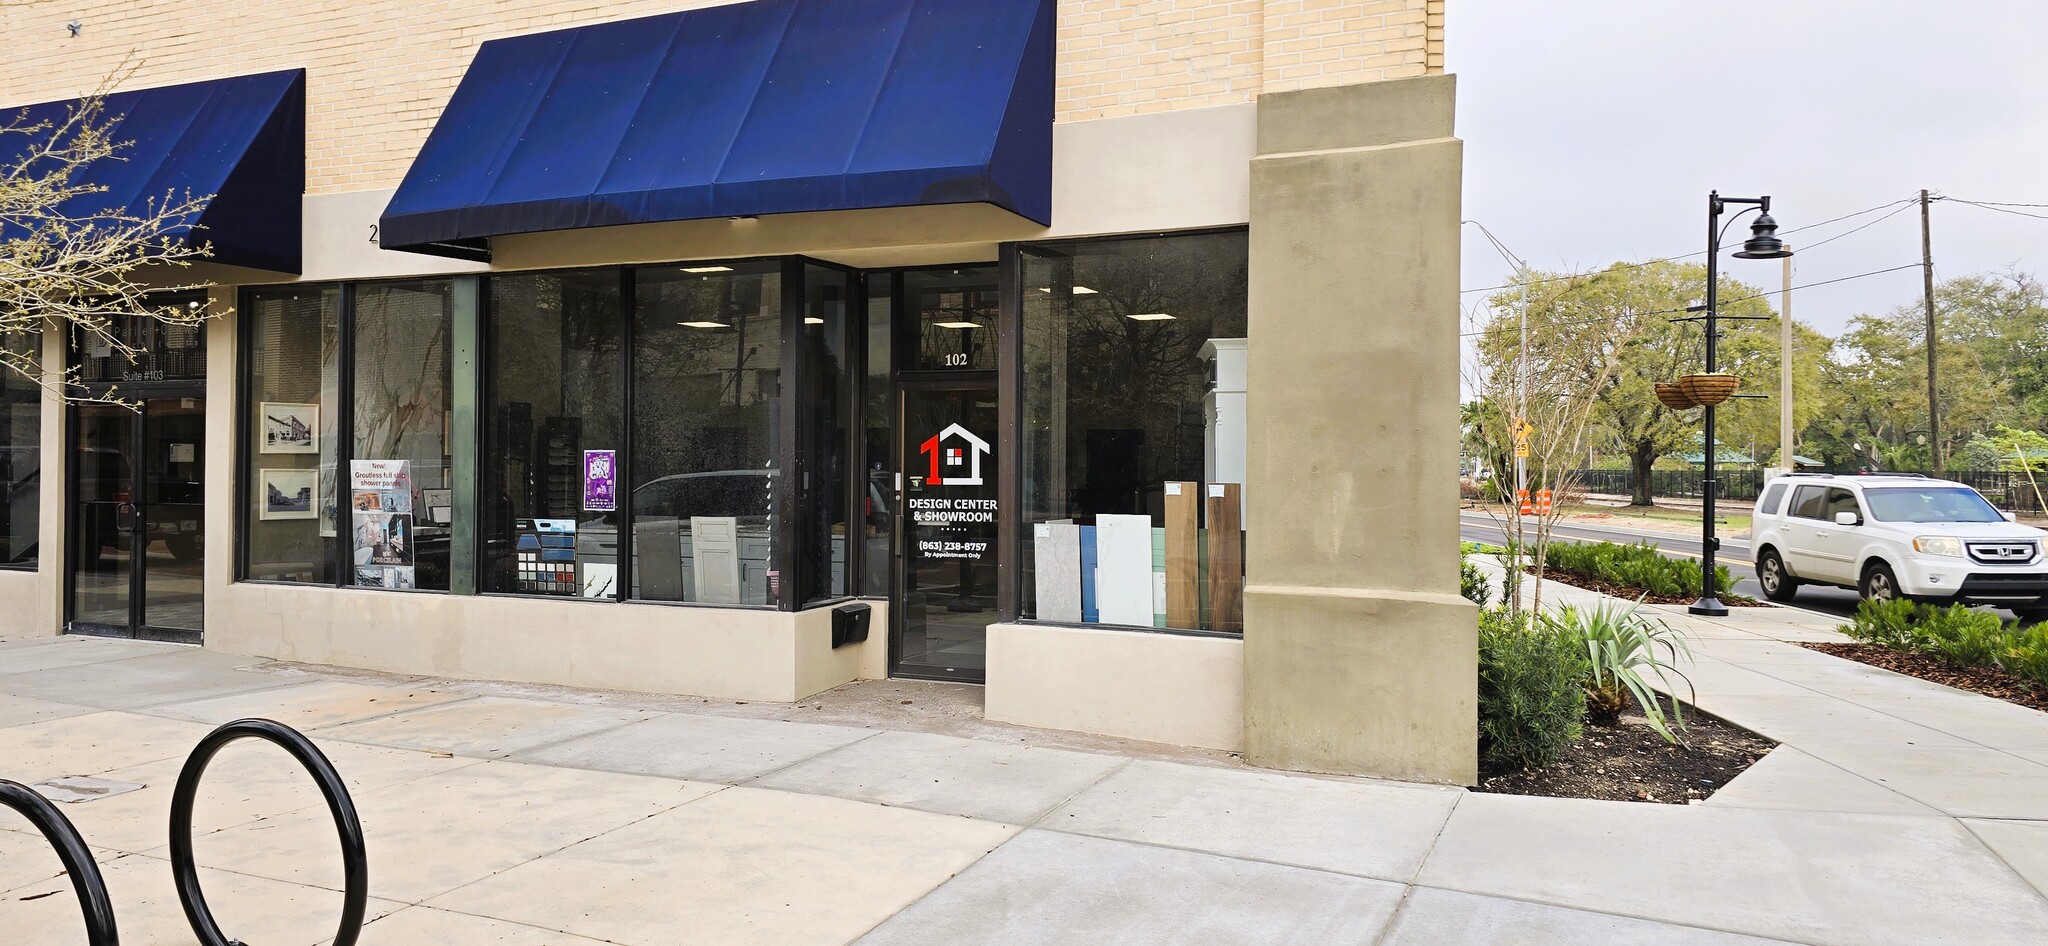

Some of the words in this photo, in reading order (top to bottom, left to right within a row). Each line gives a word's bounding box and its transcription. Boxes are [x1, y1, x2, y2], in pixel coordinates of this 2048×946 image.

[369, 224, 378, 242] 2
[945, 353, 968, 366] 102
[122, 371, 143, 381] Suite
[144, 370, 164, 381] #103
[909, 498, 951, 509] DESIGN
[954, 499, 998, 510] CENTER
[913, 511, 922, 521] &
[924, 511, 993, 522] SHOWROOM
[919, 540, 942, 551] (863)
[944, 541, 987, 552] 238-8757
[933, 551, 968, 559] Appointment
